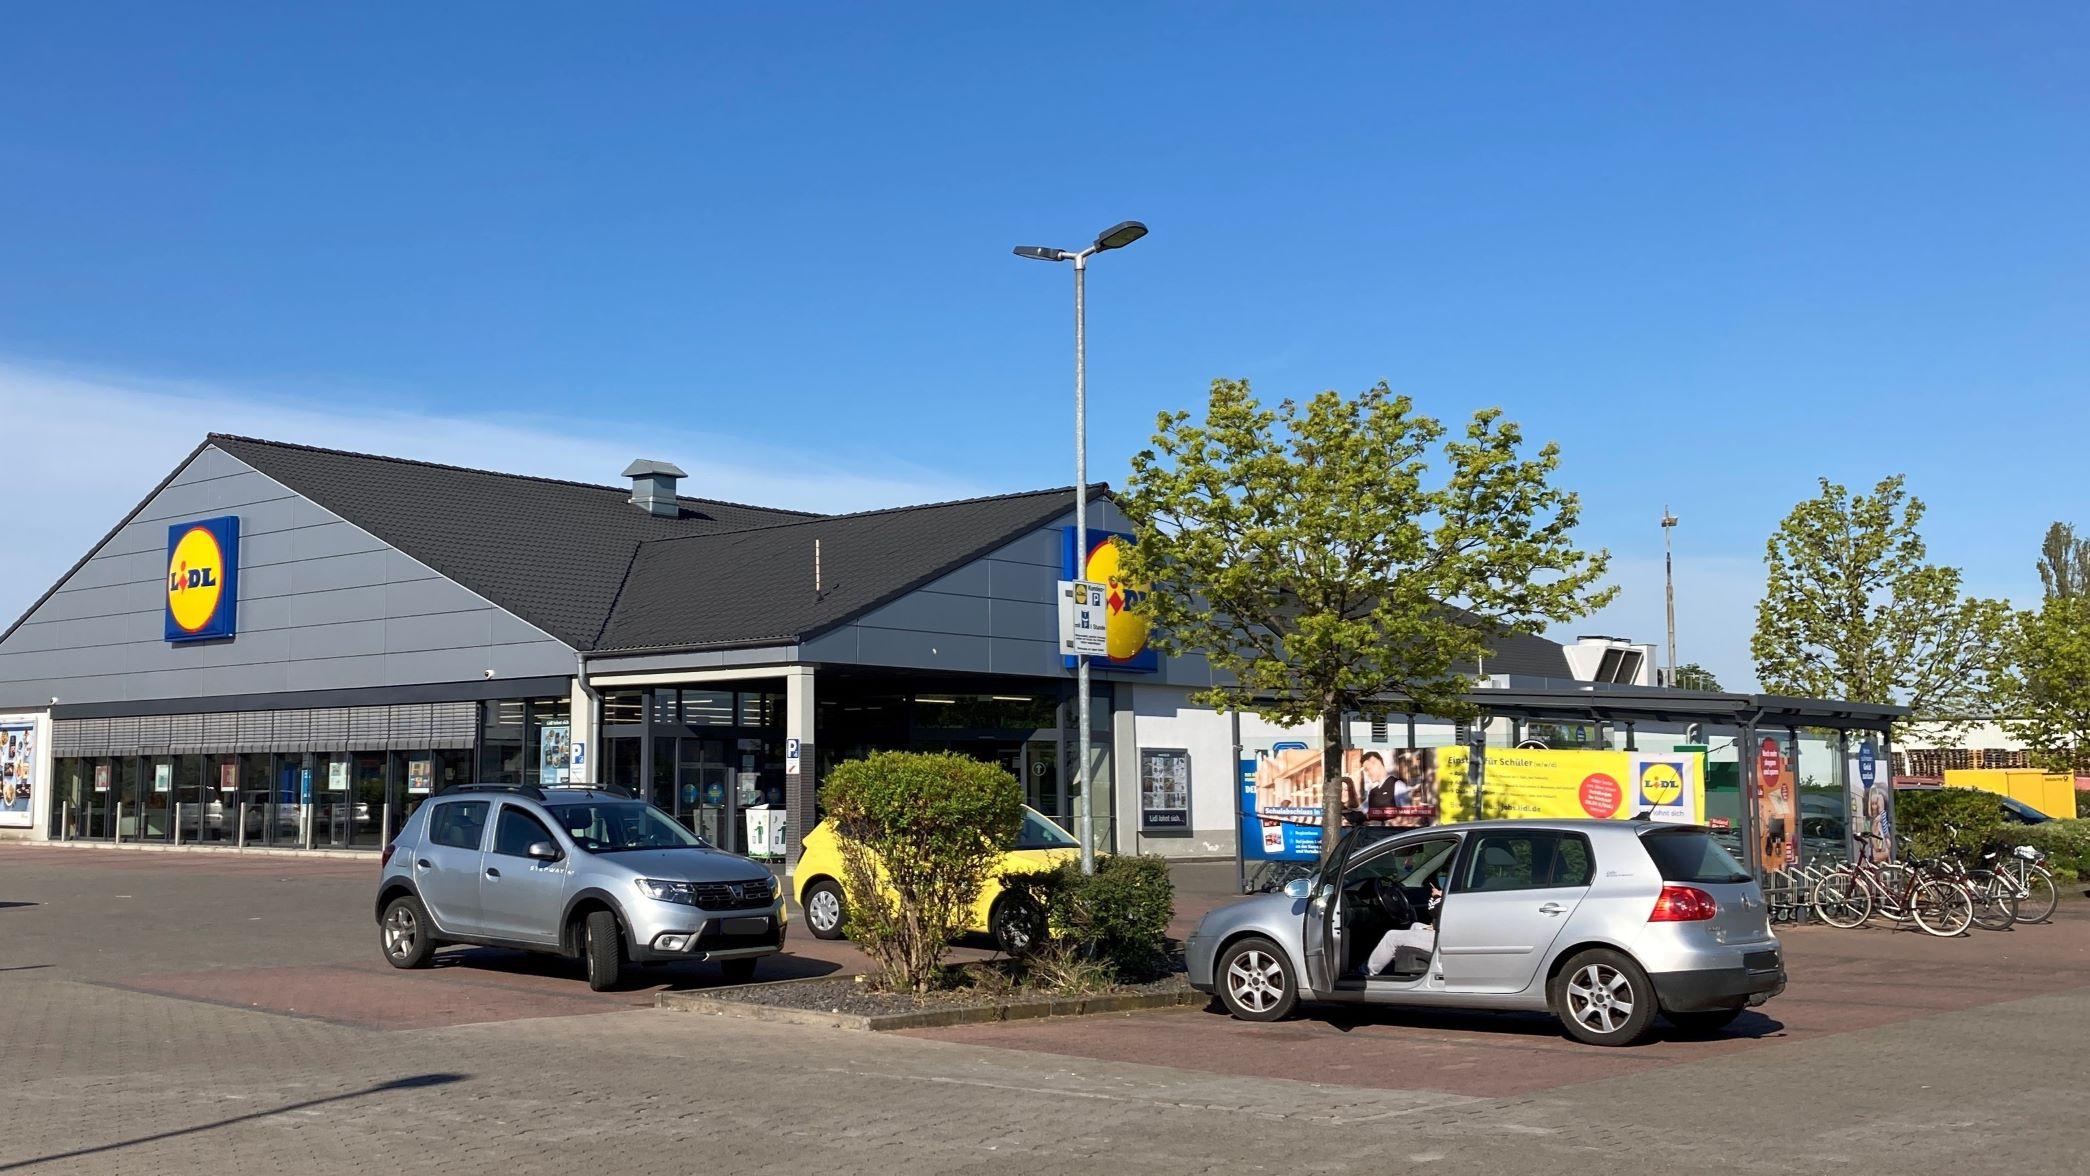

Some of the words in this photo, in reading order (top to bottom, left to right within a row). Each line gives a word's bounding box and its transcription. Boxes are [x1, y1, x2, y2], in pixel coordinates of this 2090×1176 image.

[571, 744, 582, 764] P
[788, 740, 797, 757] P
[1500, 758, 1532, 766] Schüler
